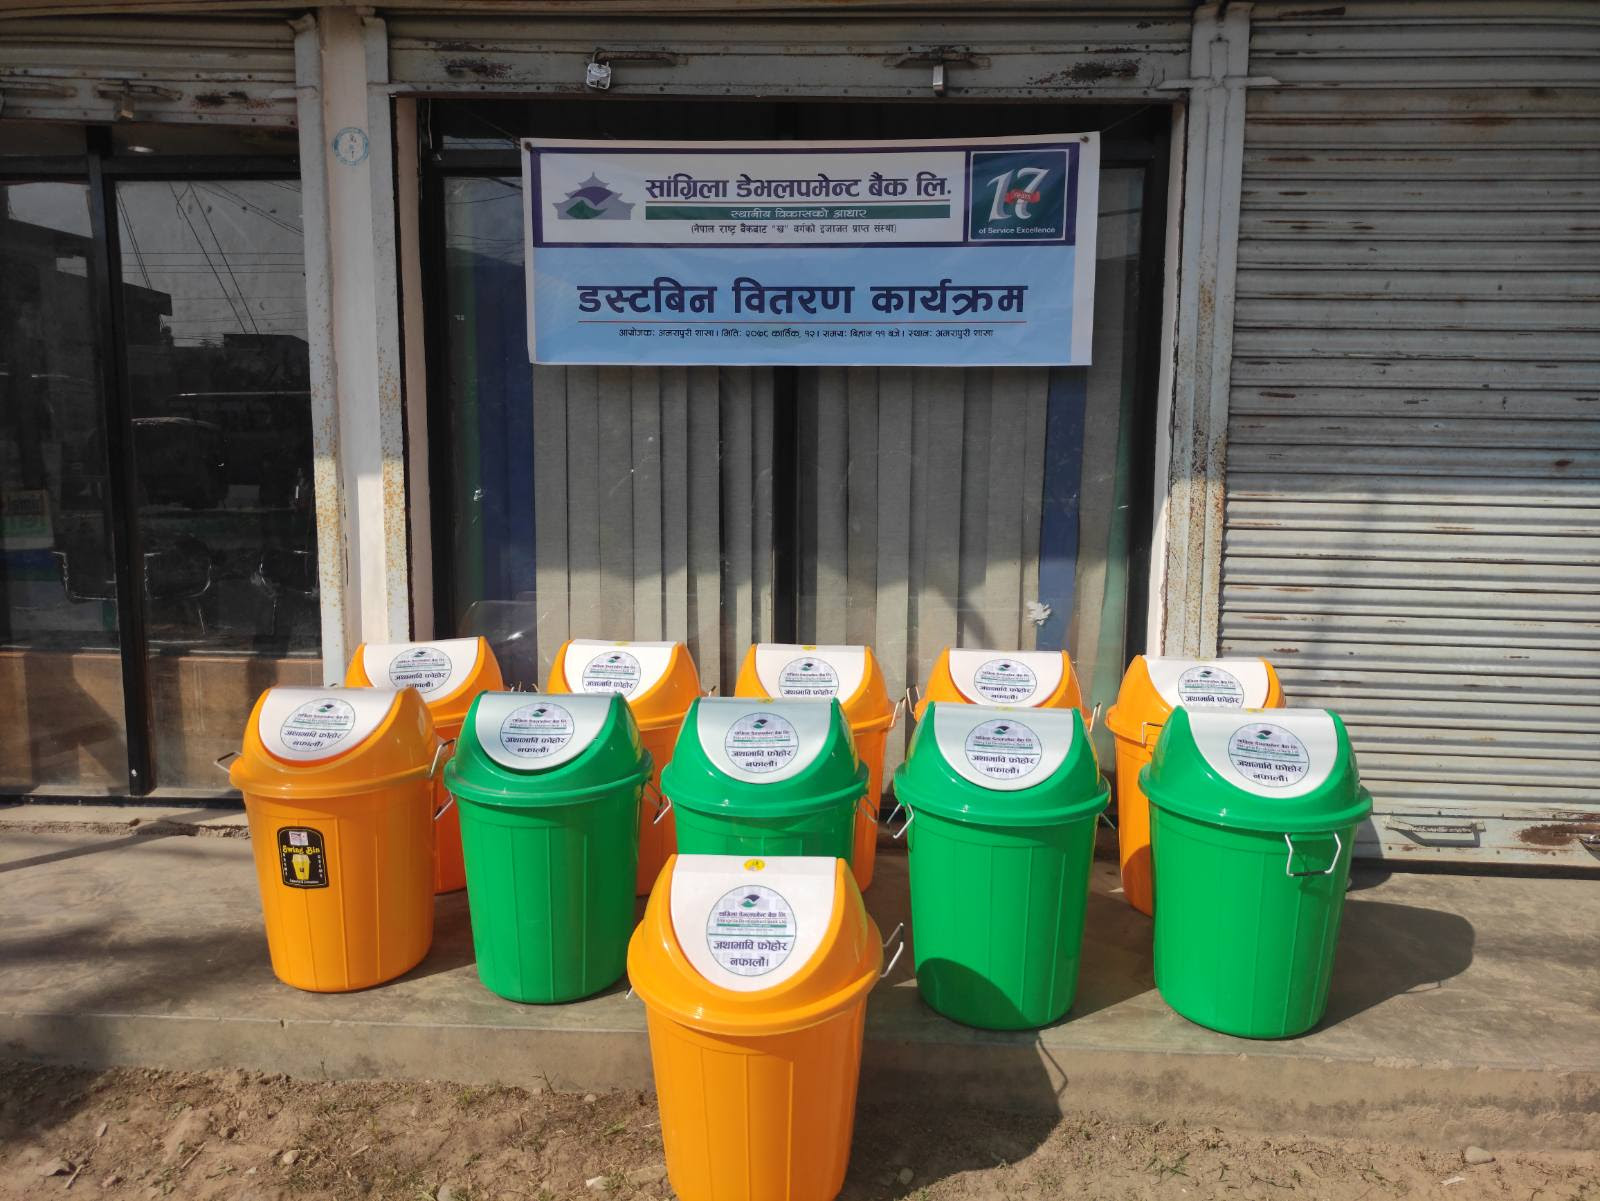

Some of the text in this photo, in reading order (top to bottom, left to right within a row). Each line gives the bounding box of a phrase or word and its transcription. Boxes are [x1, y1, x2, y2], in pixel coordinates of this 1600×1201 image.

[645, 171, 952, 200] सांग्रिला डेभलपमेन्ट बैंक लि.
[986, 167, 1051, 222] 17
[729, 207, 867, 219] स्थानीय विकासको आधार
[1016, 226, 1056, 234] Excellence
[577, 277, 1029, 316] डस्टबिन वितरण कार्यक्रम
[282, 844, 320, 855] Swing Bin
